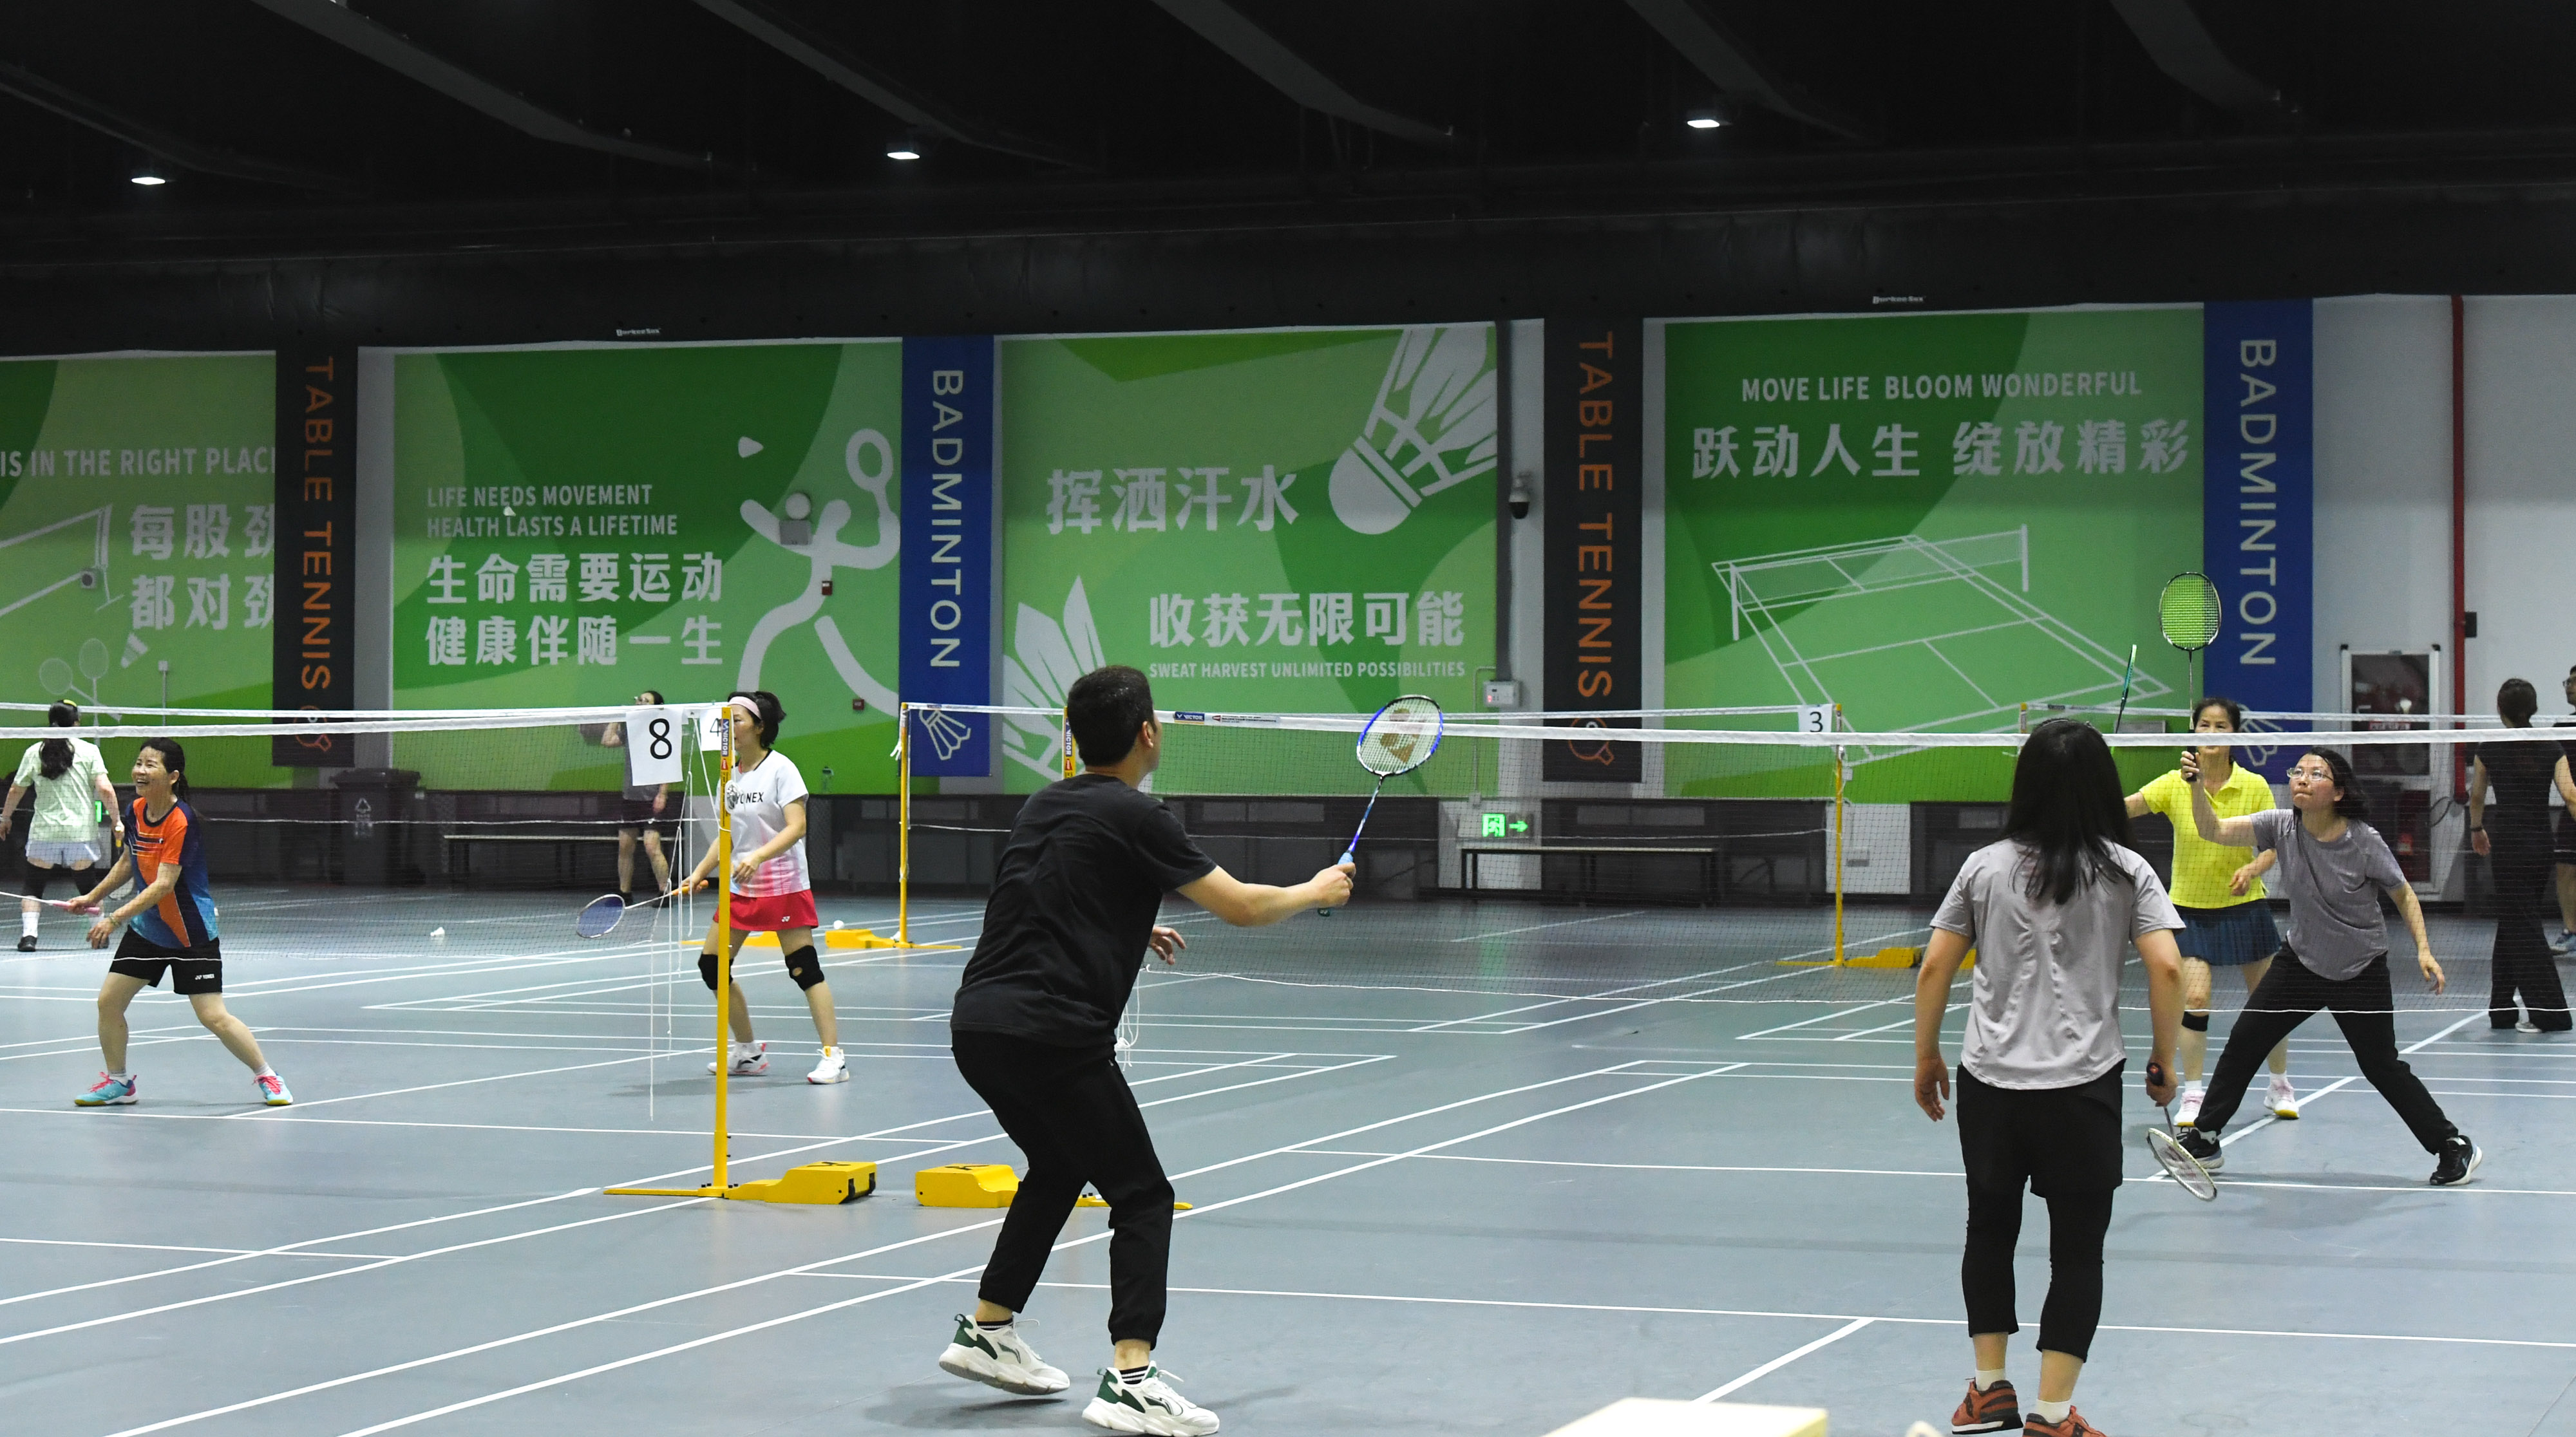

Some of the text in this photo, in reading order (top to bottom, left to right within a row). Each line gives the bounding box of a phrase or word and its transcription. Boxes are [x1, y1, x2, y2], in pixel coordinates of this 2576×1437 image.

[1742, 371, 2141, 402] MOVE LIFE BLOOM WONDERFUL
[32, 450, 55, 477] IN
[64, 450, 111, 476] THE
[120, 447, 197, 475] RIGHT
[205, 447, 275, 474] PLAC
[1692, 418, 2188, 479] 跃动人生 绽放精彩
[427, 484, 652, 508] LIFE NEEDS MOVEMENT
[930, 369, 963, 667] BADMINTON
[1046, 464, 1299, 535] 挥洒汗水
[1578, 331, 1613, 697] TABLE TENNIS
[2240, 339, 2277, 664] BADMINTON
[301, 356, 334, 690] TABLE TENNIS
[427, 514, 677, 538] HEALTH LASTS A LIFETIME
[426, 552, 723, 604] 生命需要运动
[426, 615, 723, 666] 健康伴随一生
[1150, 590, 1464, 648] 收获无限可能
[1150, 661, 1466, 679] SWEAT HARVEST UNLIMITED POSSIBILITIES
[649, 718, 672, 760] 8
[710, 718, 722, 737] 4
[1810, 711, 1823, 733] 3
